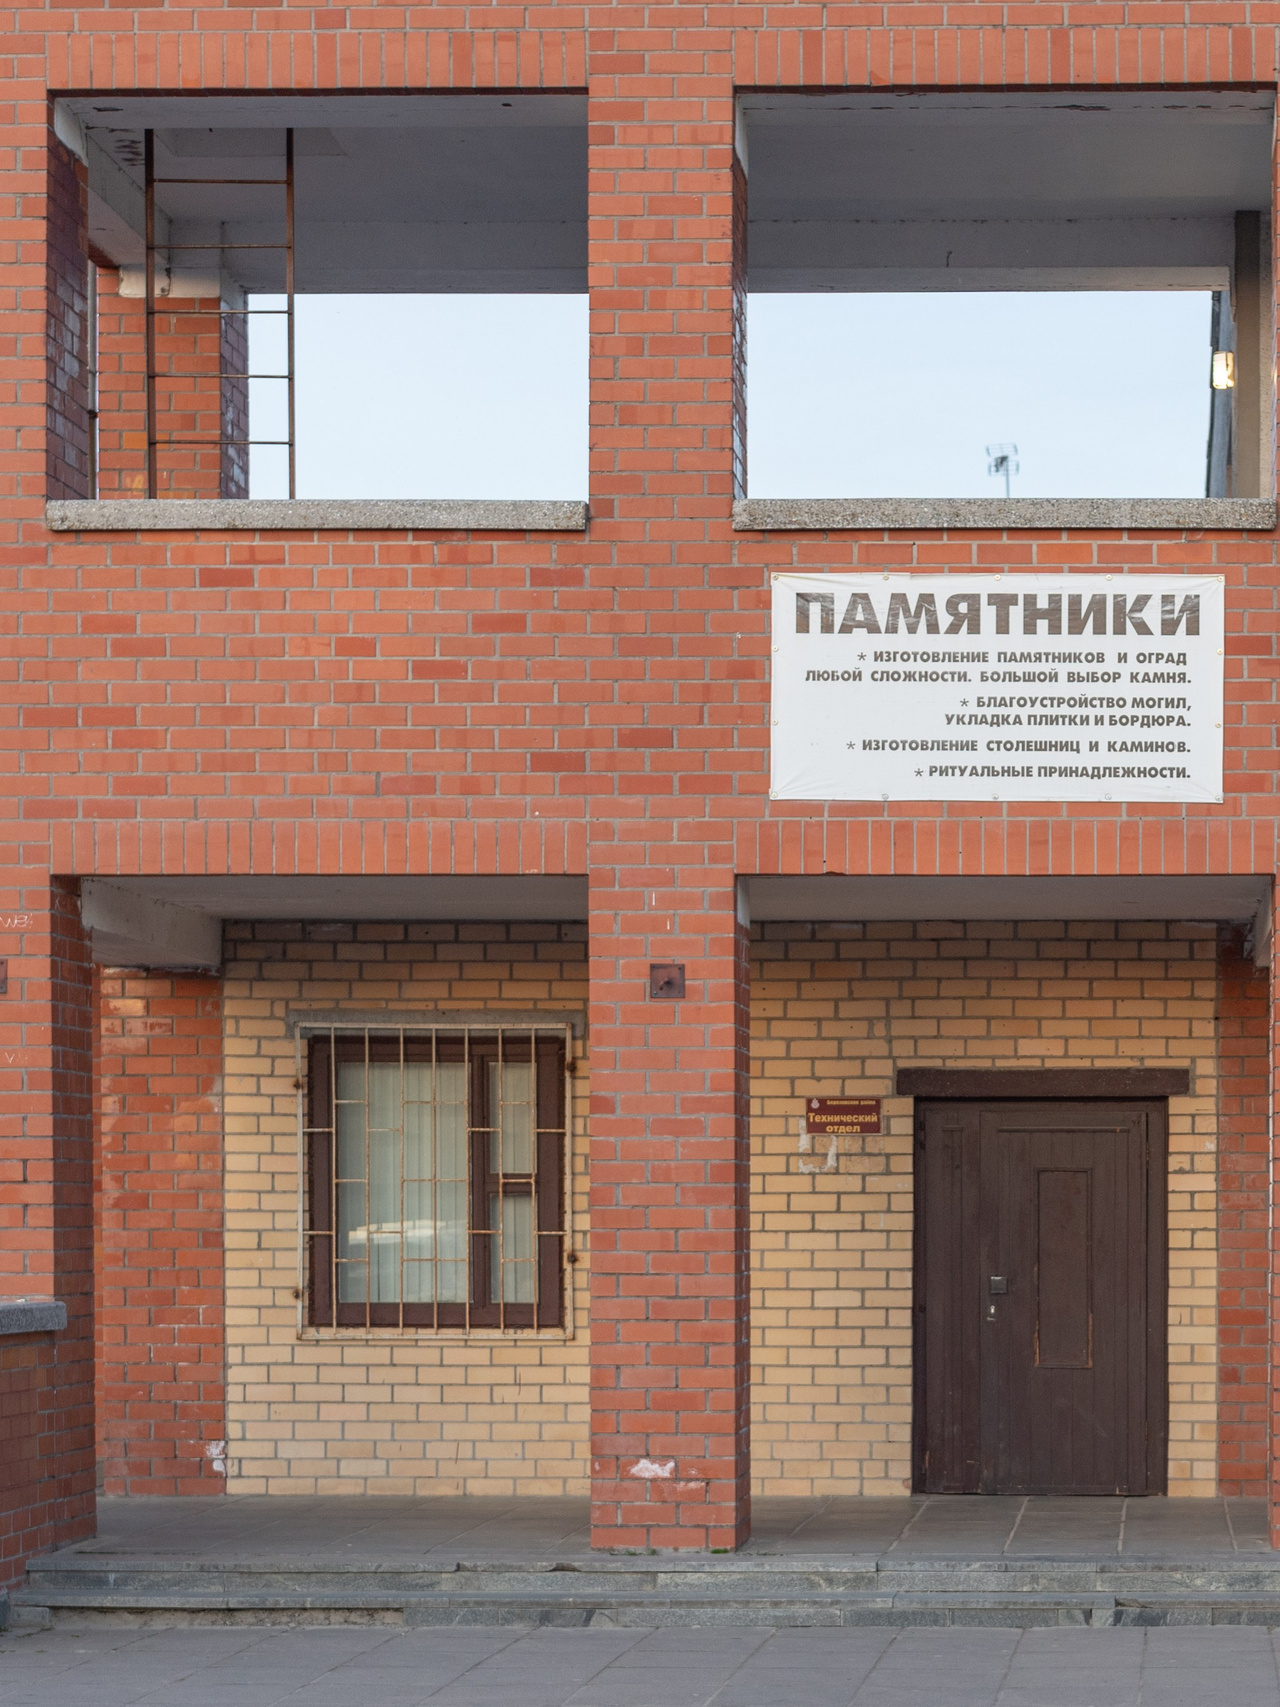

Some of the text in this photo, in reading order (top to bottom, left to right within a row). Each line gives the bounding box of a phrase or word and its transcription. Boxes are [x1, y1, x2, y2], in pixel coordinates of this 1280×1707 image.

[795, 592, 1200, 635] ПАМЯТНИКИ
[873, 650, 1187, 666] ИЗГОТОВЛЕНИЕ ПАМЯТНИКОВ И ОГРАД
[805, 667, 1192, 684] ЛЮБОЙ СЛОЖНОСТИ. БОЛЬШОЙ ВЫБОР КАМНЯ.
[976, 693, 1192, 711] БЛАГОУСТРОЙСТВО МОГИЛ,
[945, 713, 1192, 729] УКЛАДКА ПЛИТКИ И БОРДЮРА.
[862, 739, 1191, 755] ИЗГОТОВЛЕНИЕ СТОЛЕШНИЦ И КАМИНОВ.
[928, 765, 1191, 780] РИТУАЛЬНЫЕ ПРИНАДЛЕЖНОСТИ.
[808, 1112, 878, 1122] Технический
[826, 1125, 860, 1133] отдел
